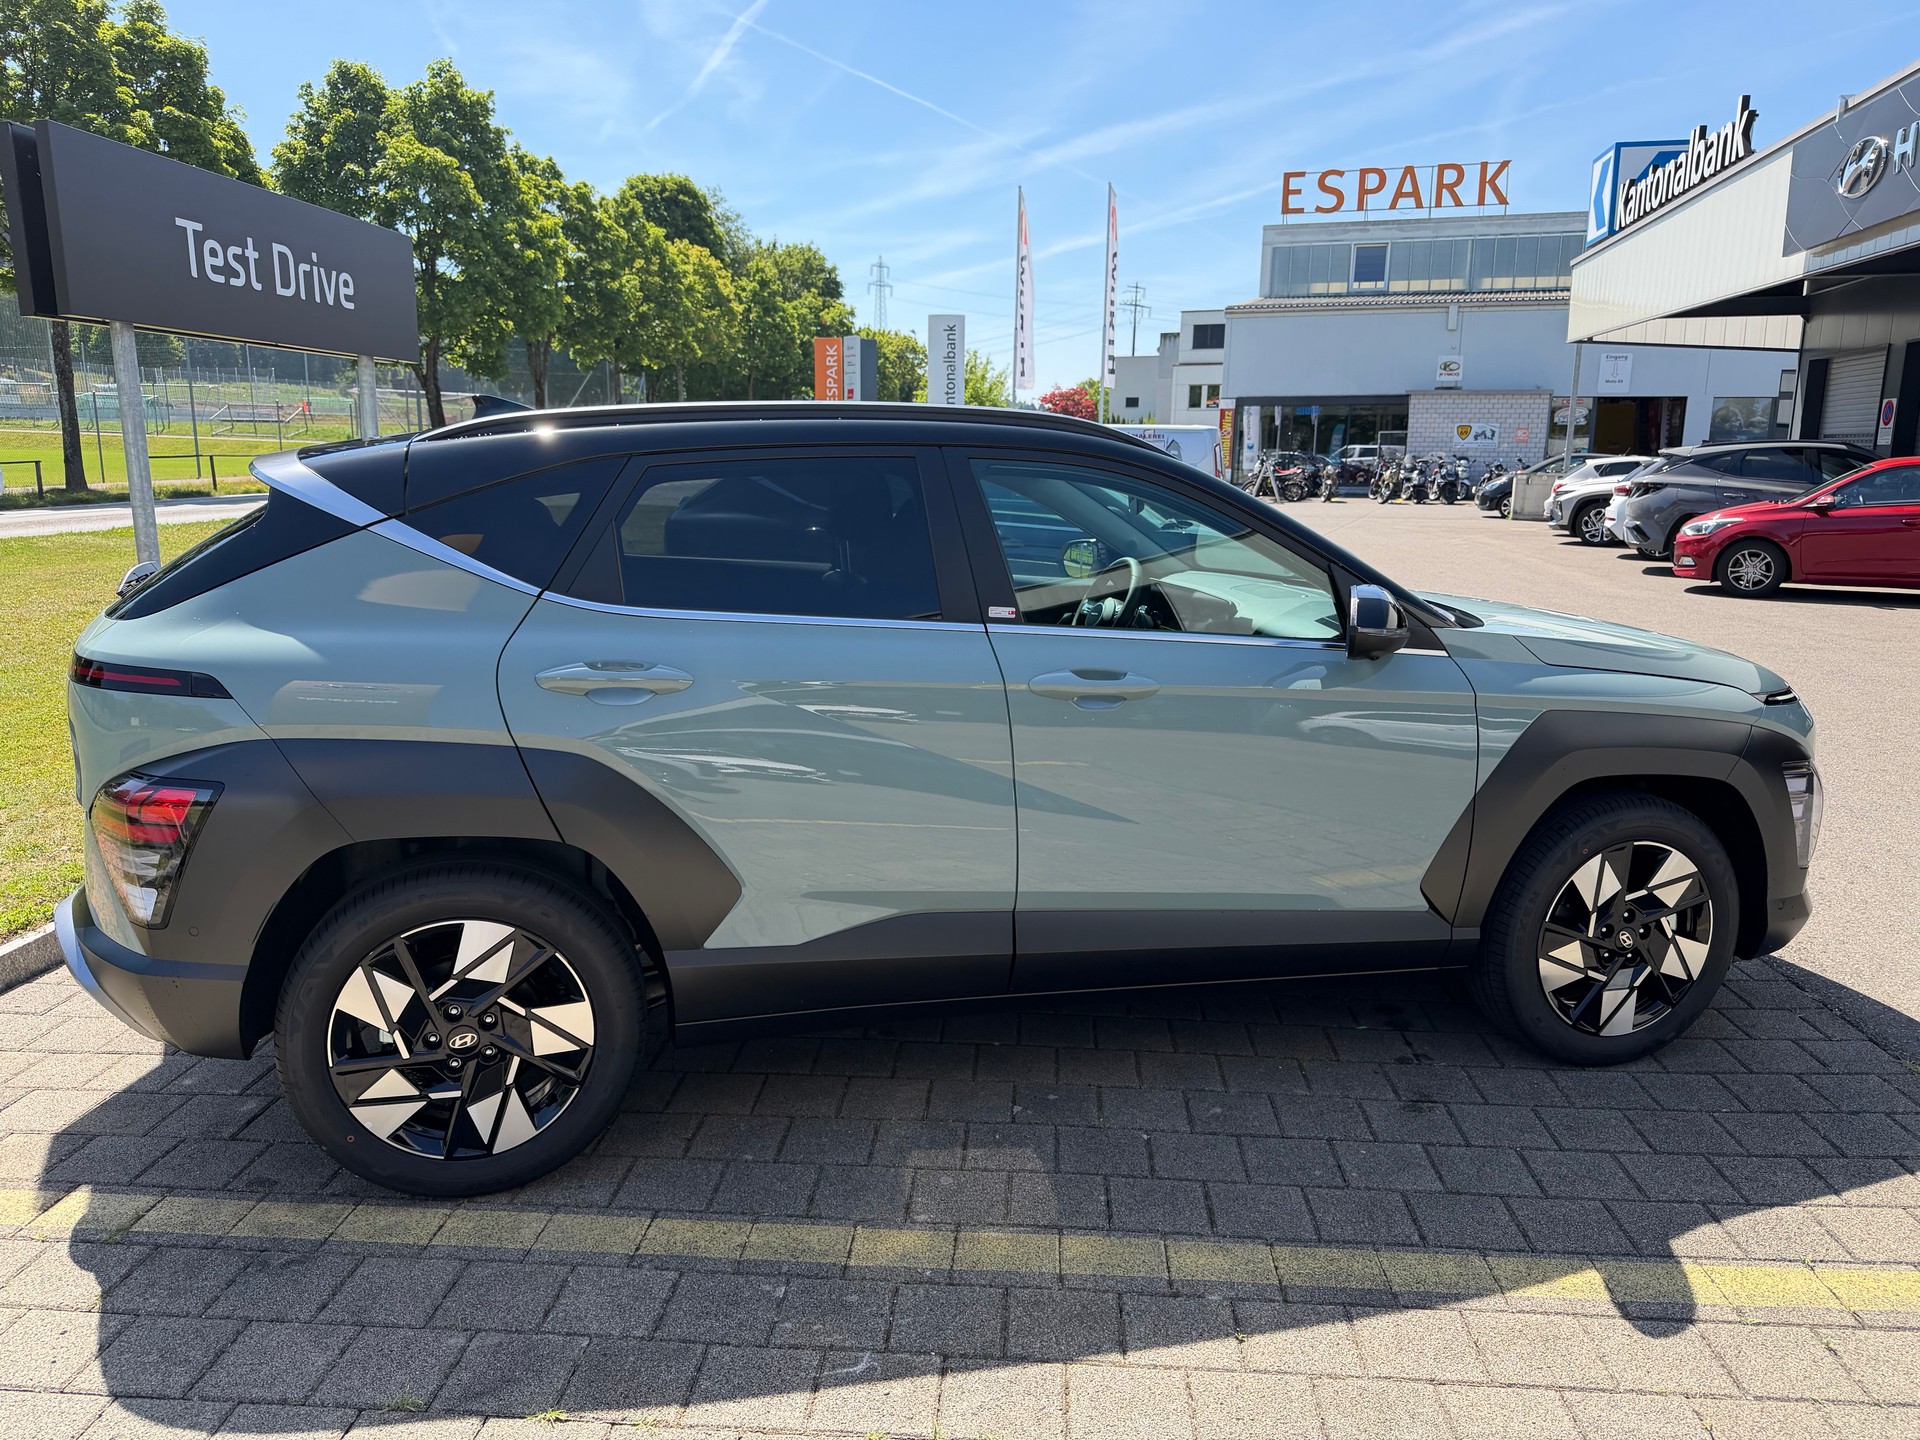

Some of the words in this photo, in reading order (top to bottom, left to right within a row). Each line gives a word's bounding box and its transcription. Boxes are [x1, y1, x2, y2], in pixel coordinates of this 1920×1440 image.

[1614, 95, 1757, 231] Kantonalbank
[1893, 120, 1920, 173] H
[1281, 160, 1512, 214] ESPARK
[175, 217, 262, 291] Test
[272, 242, 355, 310] Drive
[1222, 411, 1232, 430] Wirz
